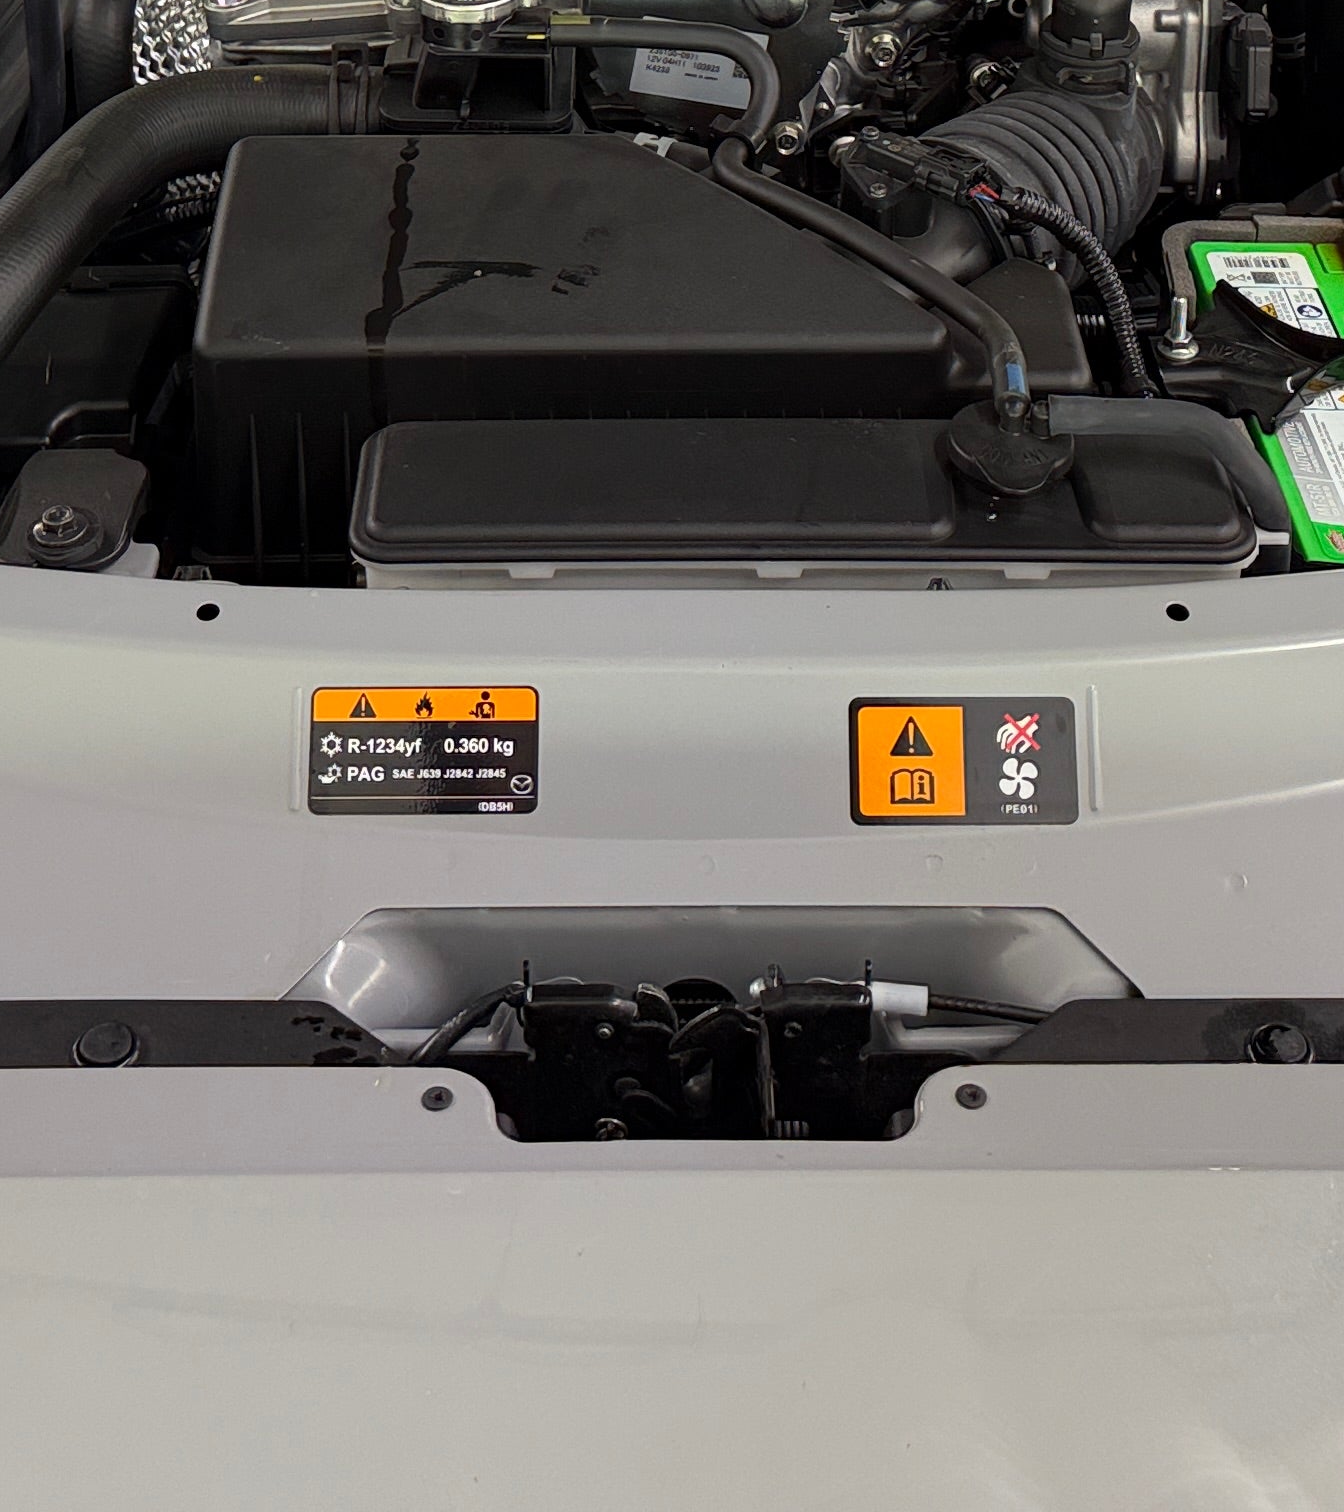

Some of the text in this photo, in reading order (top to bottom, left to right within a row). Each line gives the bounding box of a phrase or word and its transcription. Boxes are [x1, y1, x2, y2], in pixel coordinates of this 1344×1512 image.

[347, 738, 514, 757] R-1234yf 0.360 kg
[347, 766, 507, 781] PAG SAE J639 J2842 J2845
[1000, 803, 1038, 815] (PE01)
